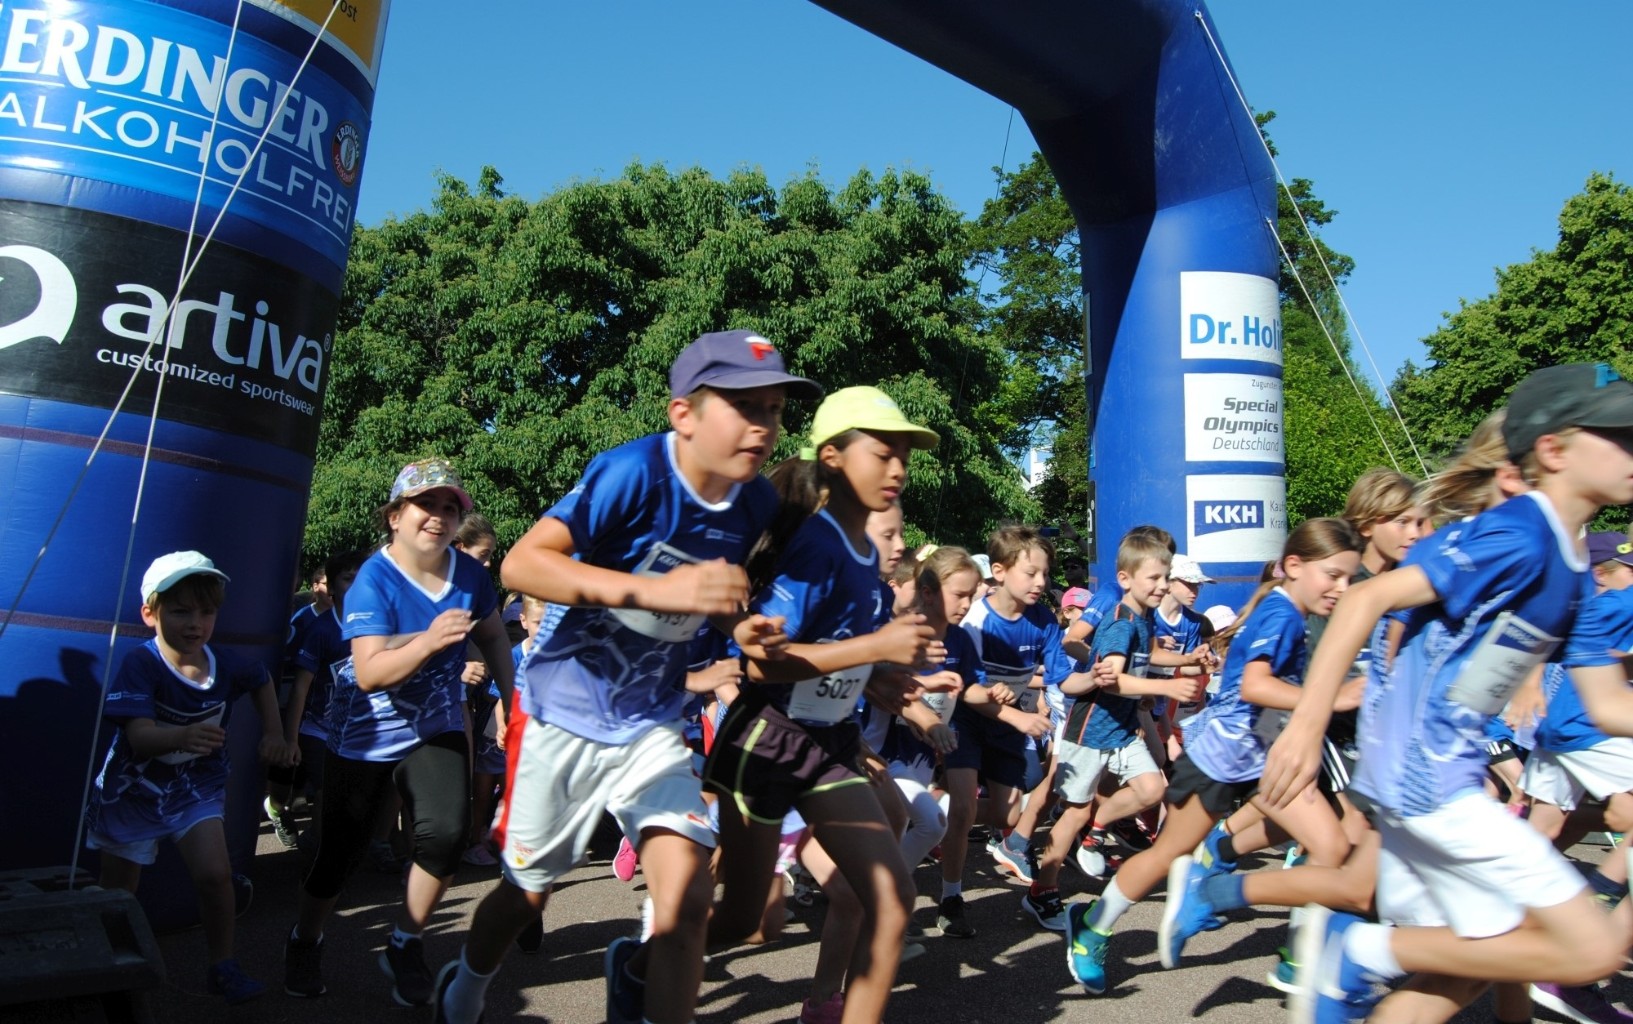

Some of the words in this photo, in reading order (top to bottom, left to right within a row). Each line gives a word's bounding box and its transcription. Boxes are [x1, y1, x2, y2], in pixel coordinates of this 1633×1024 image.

[0, 8, 327, 171] ERDINGER
[0, 92, 353, 234] ALKOHOLFREI
[1189, 313, 1238, 345] Dr.
[96, 349, 235, 390] customized
[241, 380, 316, 417] sportswear
[1223, 397, 1279, 414] Special
[1203, 416, 1280, 435] Olympics
[1212, 436, 1280, 452] Deutschland
[1204, 504, 1258, 525] KKH
